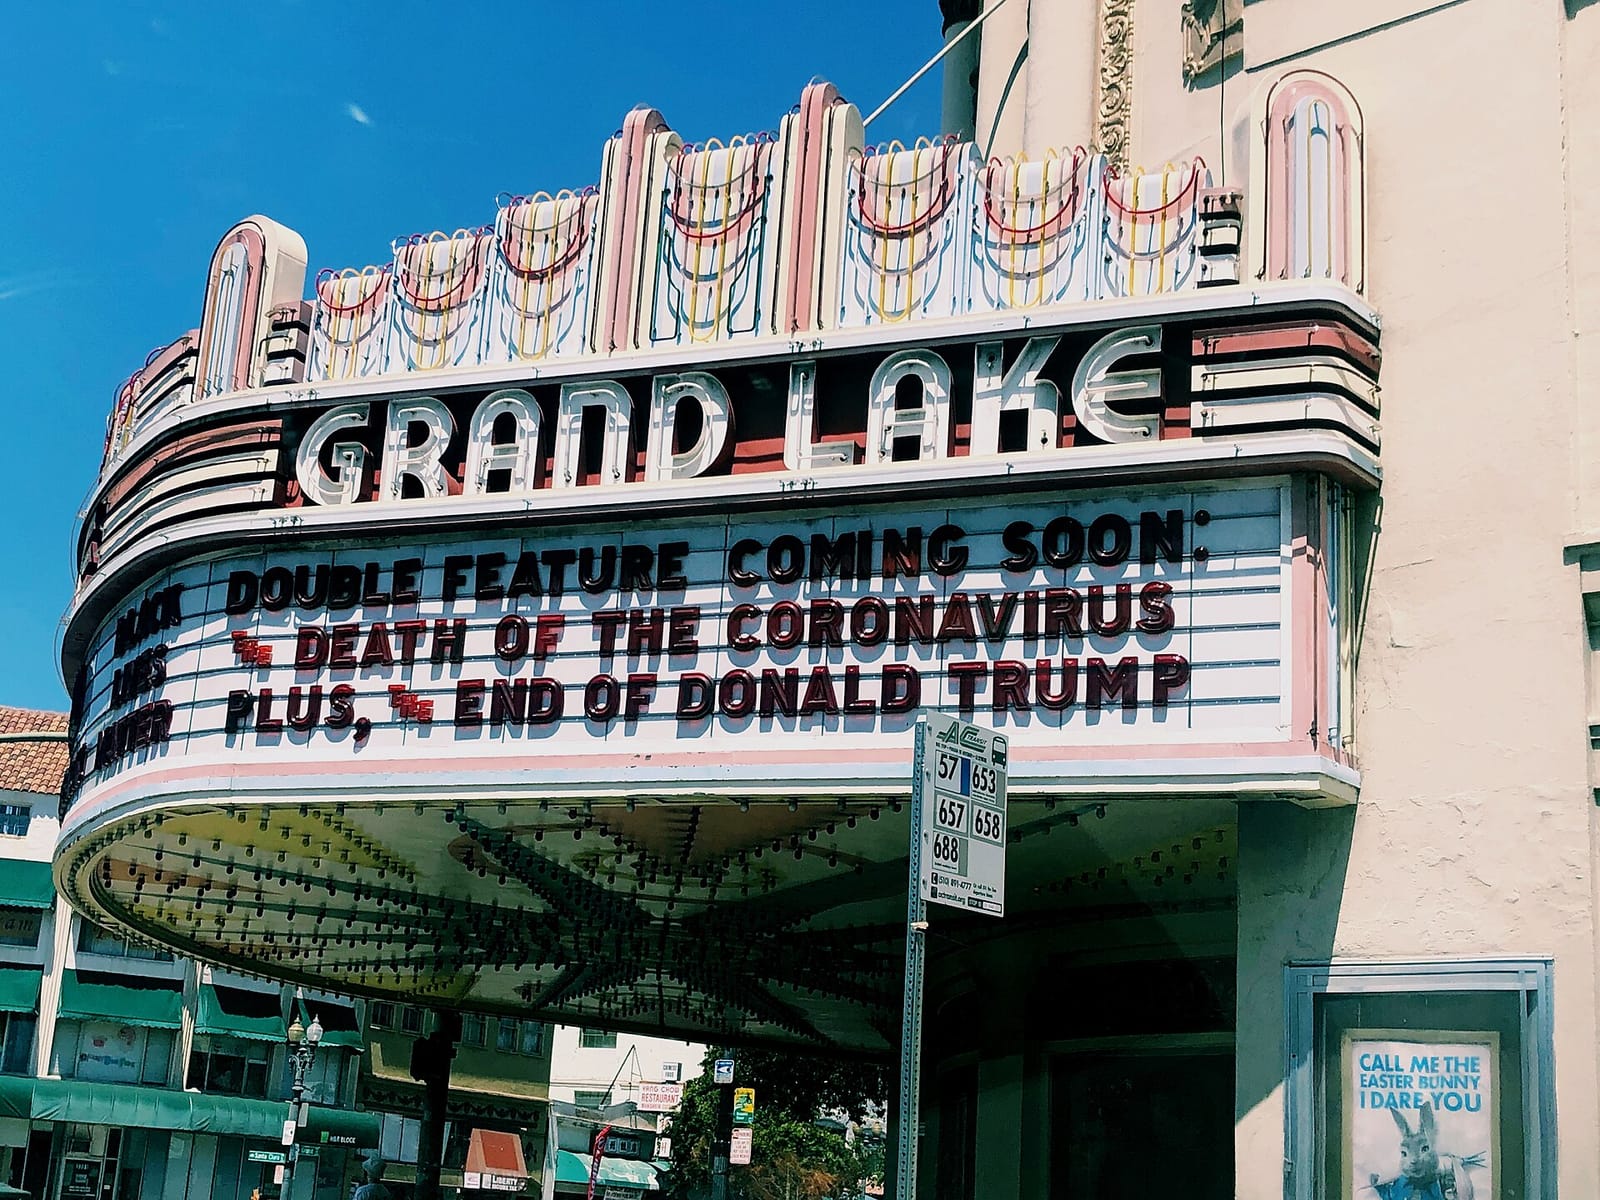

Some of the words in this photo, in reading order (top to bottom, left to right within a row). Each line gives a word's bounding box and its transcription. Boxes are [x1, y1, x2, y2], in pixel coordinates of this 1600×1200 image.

[294, 372, 733, 505] GRAND
[784, 324, 1163, 472] LAKE
[225, 558, 421, 615] DOUBLE
[442, 541, 689, 601] FEATURE
[728, 524, 969, 588] COMING
[1000, 509, 1210, 572] SOON:
[294, 618, 467, 671] DEATH
[494, 613, 565, 662] OF
[591, 606, 700, 658] THE
[726, 581, 1176, 651] CORONAVIRUS
[225, 683, 372, 743] PLUS,
[454, 677, 564, 726] END
[583, 672, 657, 722] OF
[677, 663, 922, 720] DONALD
[948, 653, 1190, 713] TRUMP
[936, 721, 987, 753] AC
[967, 732, 988, 746] TRANSIT
[938, 754, 958, 781] 57
[972, 764, 996, 794] 653
[939, 798, 965, 829] 657
[975, 809, 1000, 840] 658
[934, 833, 959, 863] 688
[1359, 1053, 1404, 1073] CALL
[1410, 1056, 1439, 1073] ME
[1443, 1056, 1480, 1073] THE
[1359, 1074, 1413, 1089] EASTER
[1419, 1075, 1481, 1090] BUNNY
[641, 1093, 680, 1103] RESTAURANT
[1359, 1092, 1366, 1109] I
[1370, 1091, 1423, 1110] DARE
[1430, 1091, 1481, 1112] YOU
[340, 1136, 356, 1144] BLOCK
[492, 1175, 518, 1186] LIBERTY
